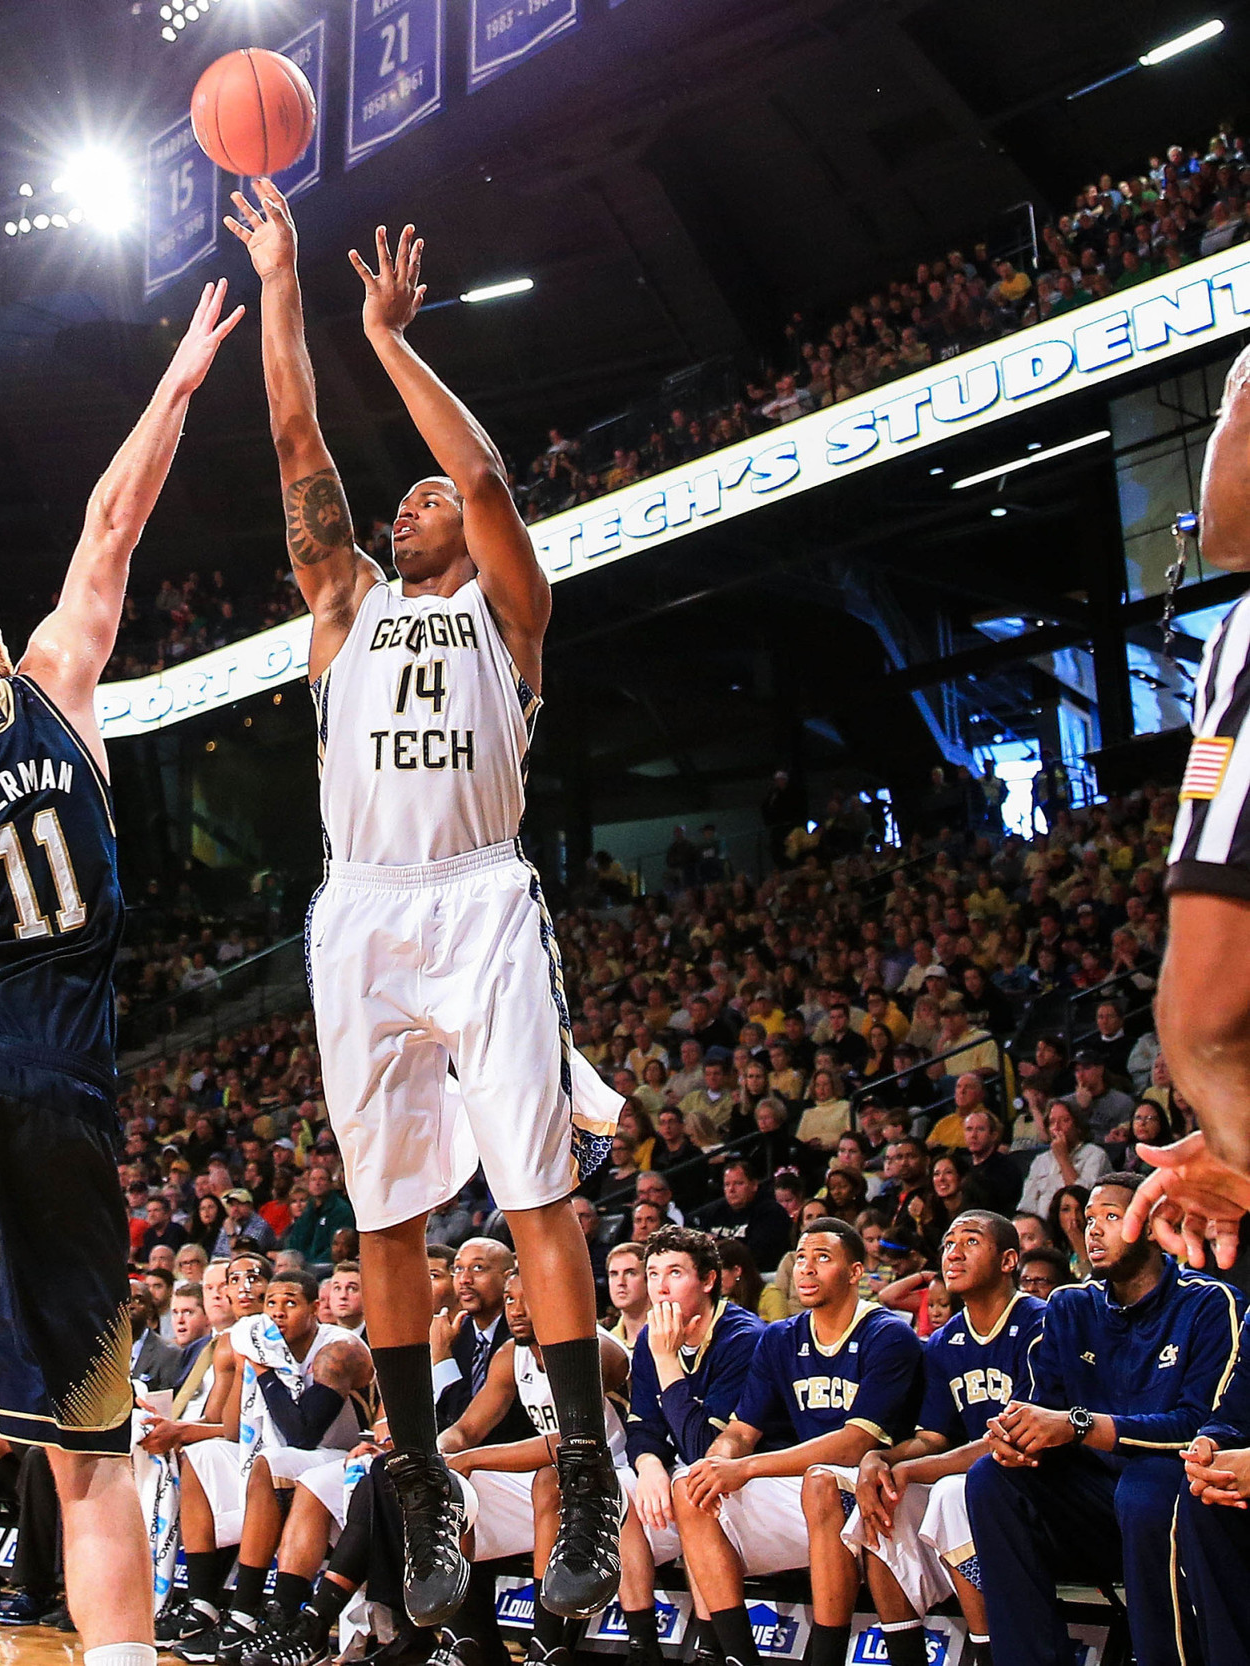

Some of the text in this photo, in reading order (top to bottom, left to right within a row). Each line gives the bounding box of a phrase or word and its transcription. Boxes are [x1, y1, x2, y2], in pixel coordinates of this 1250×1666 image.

[379, 12, 410, 77] 21
[169, 160, 194, 216] 15
[825, 261, 1250, 465] STUDENT
[537, 441, 800, 573] TECH'S
[393, 658, 451, 716] 14
[369, 729, 475, 773] TECH
